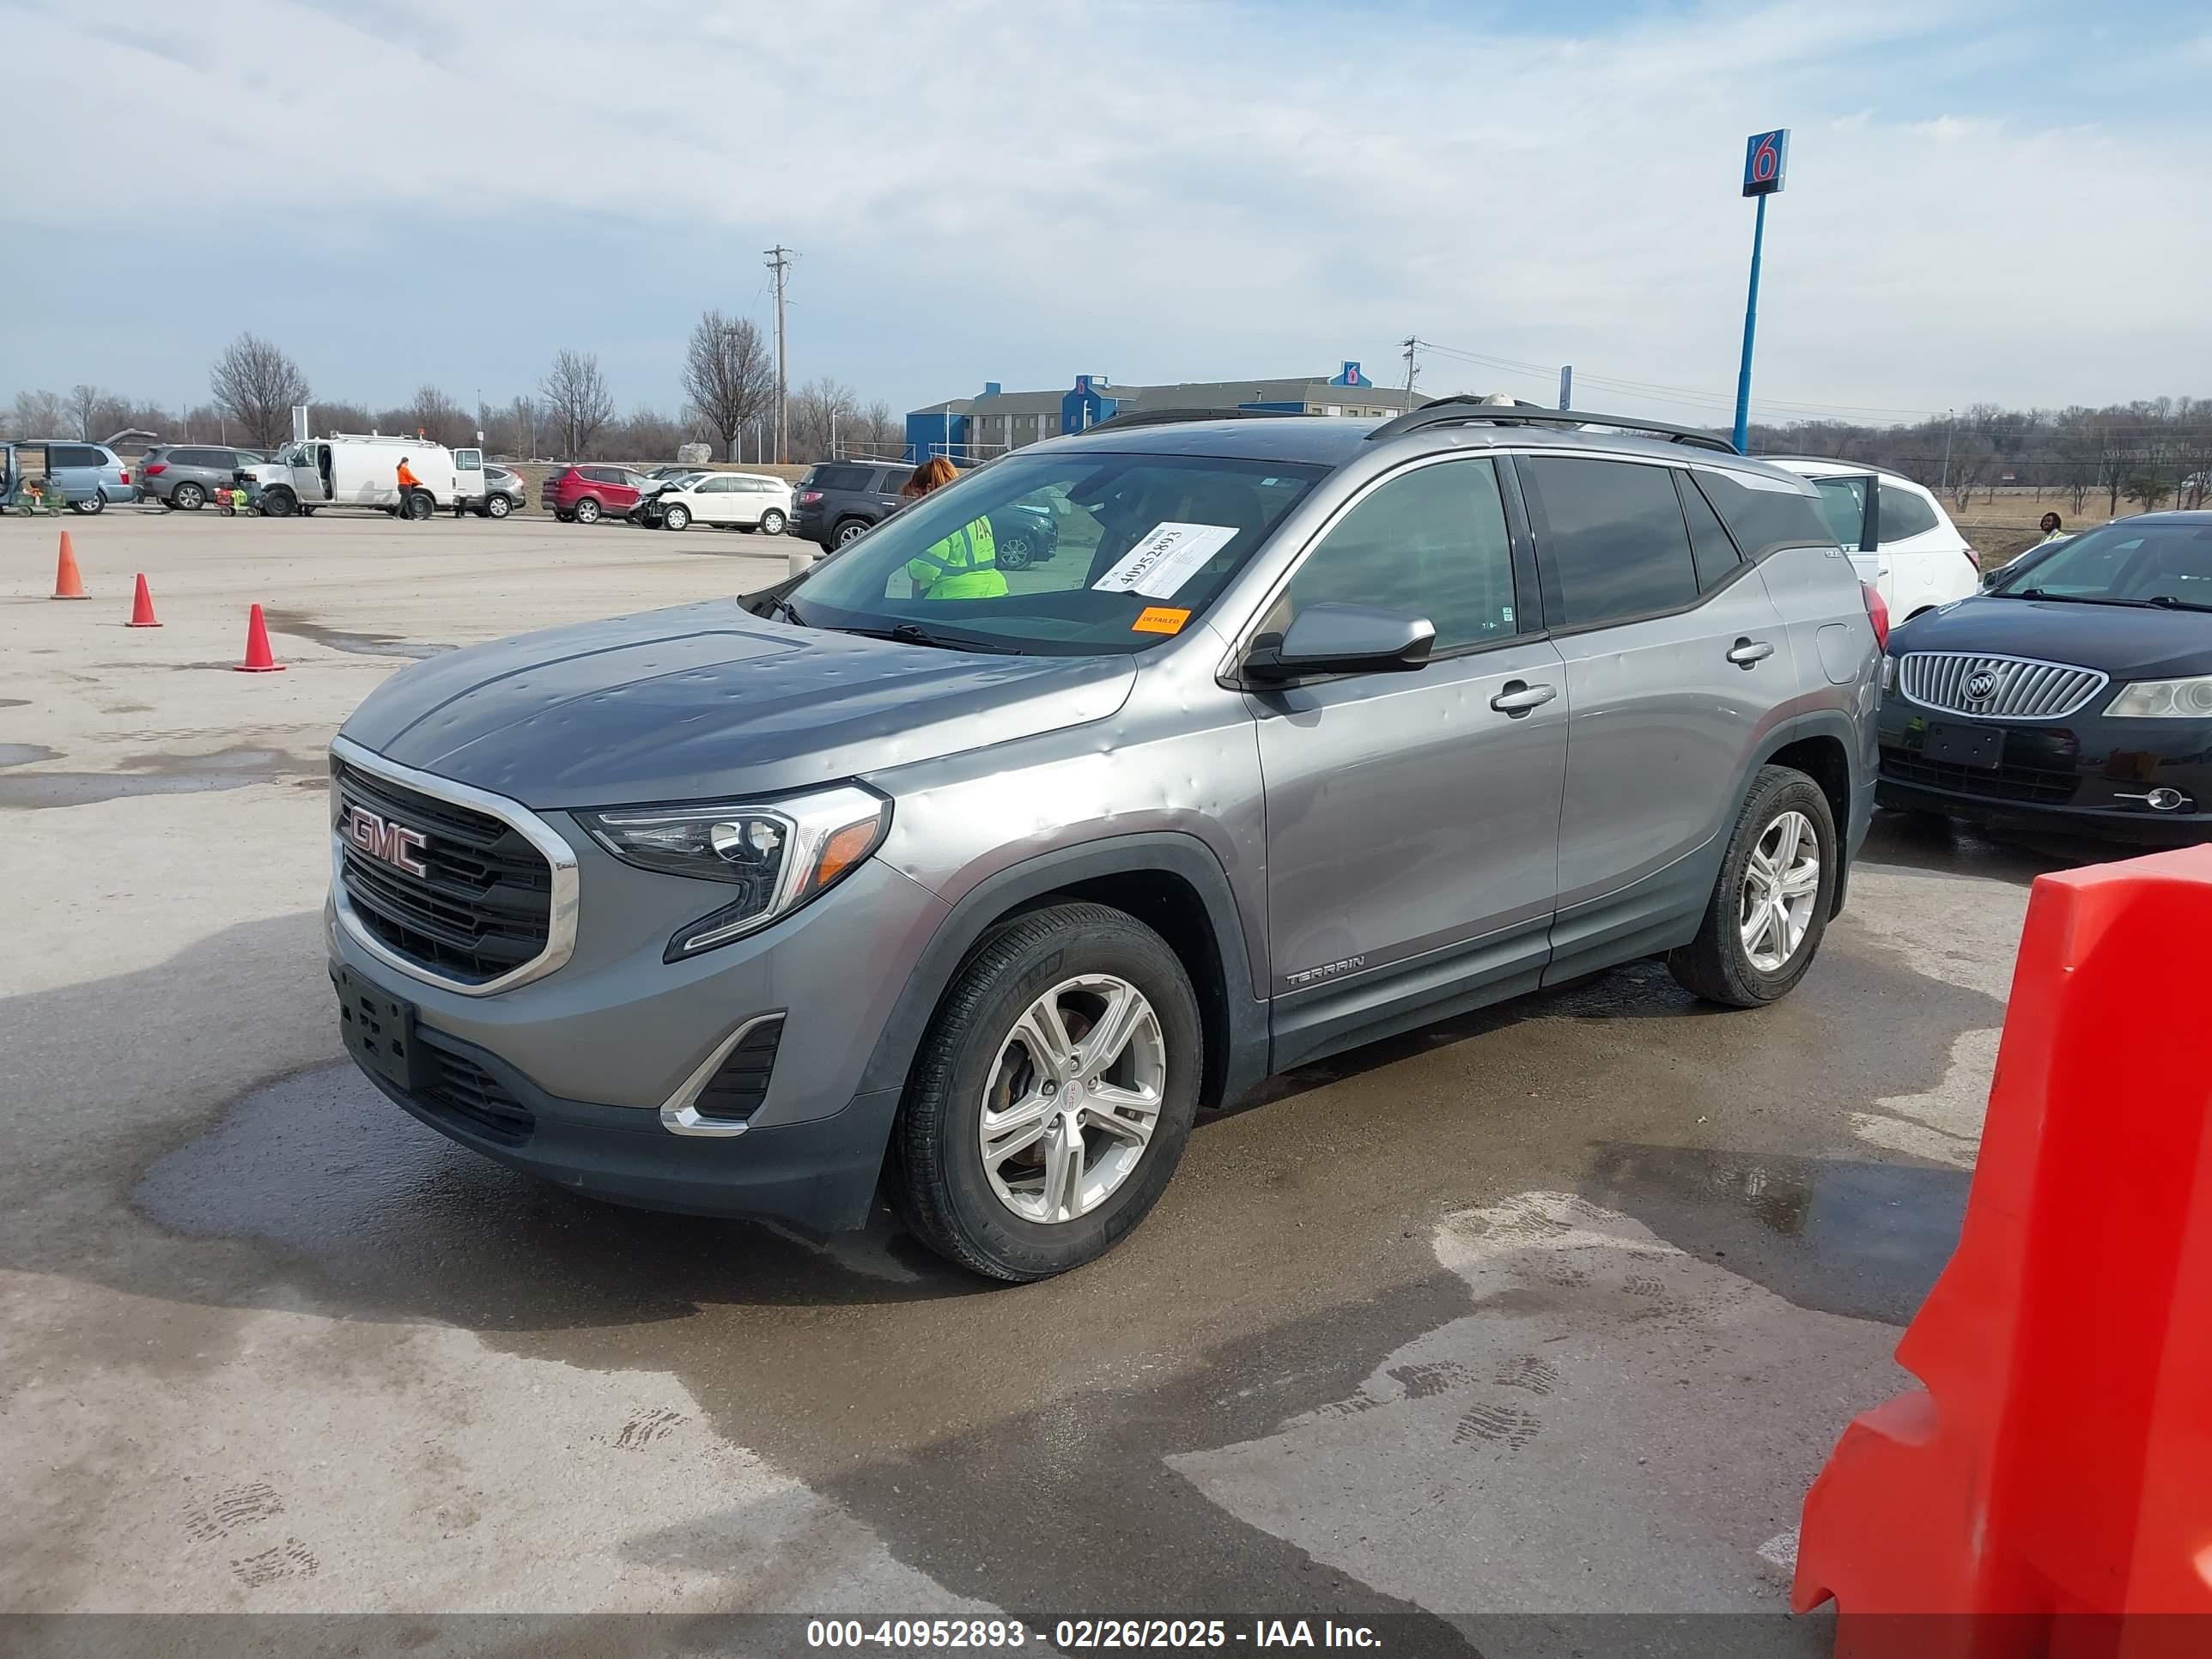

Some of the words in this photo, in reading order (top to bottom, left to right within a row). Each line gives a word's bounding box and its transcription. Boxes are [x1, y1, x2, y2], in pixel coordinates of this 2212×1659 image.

[1753, 132, 1778, 182] 6
[1120, 530, 1182, 585] 40952893
[1142, 616, 1180, 625] DETAILED
[349, 805, 427, 878] GMC
[1285, 955, 1365, 986] TERRAIN
